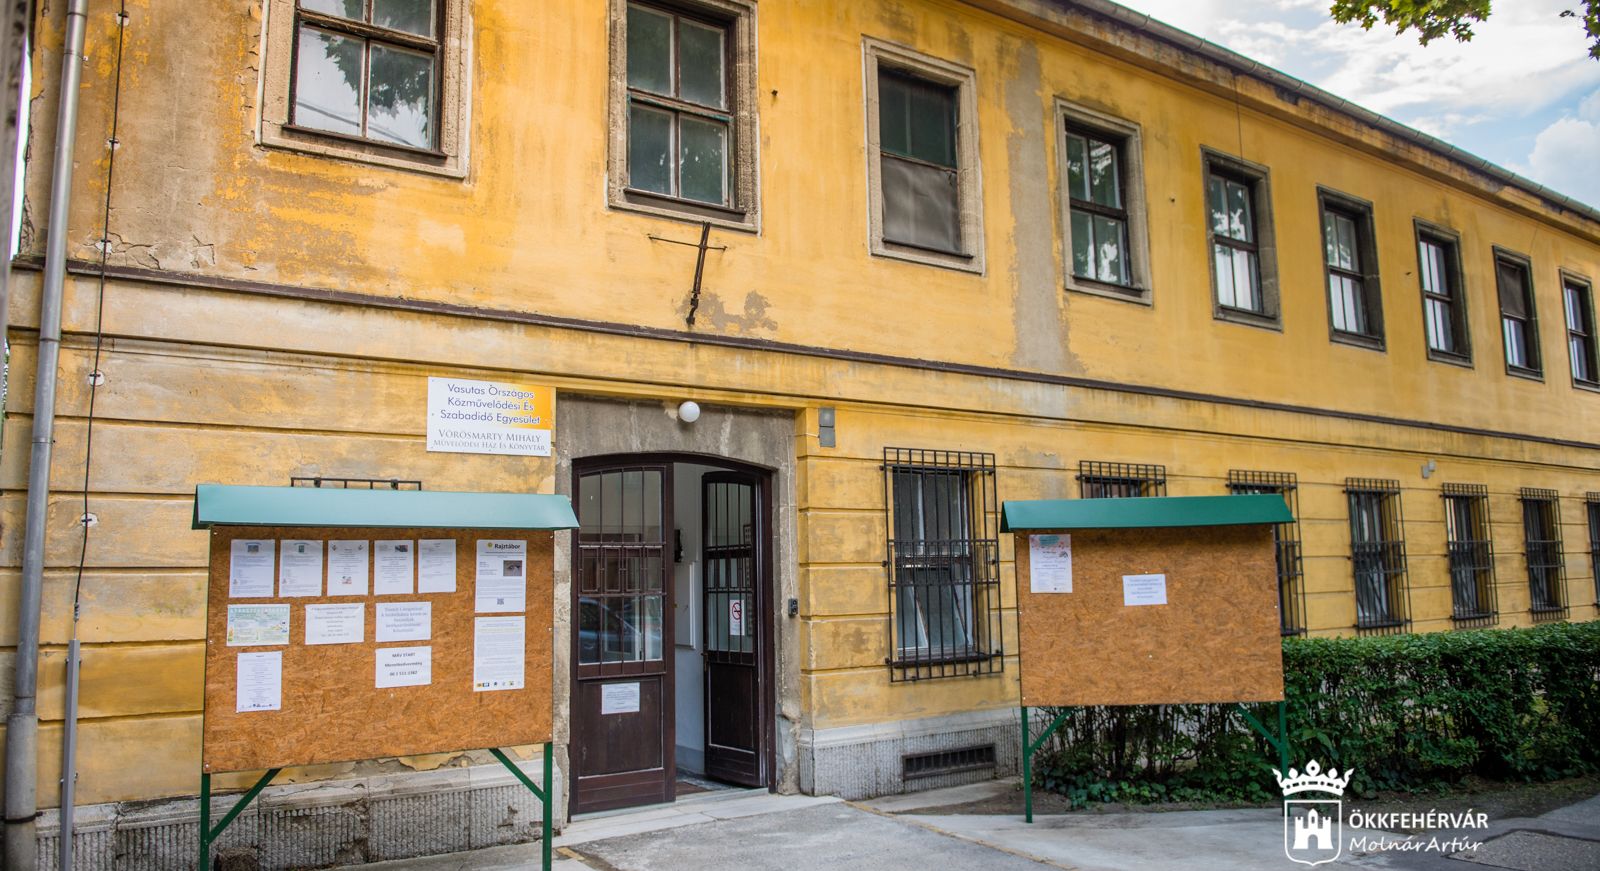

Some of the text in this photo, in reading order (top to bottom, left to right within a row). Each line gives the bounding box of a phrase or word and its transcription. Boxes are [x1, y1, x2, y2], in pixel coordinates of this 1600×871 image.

[447, 383, 486, 395] Vasutas
[447, 396, 534, 411] Közművelődési És
[440, 409, 541, 425] Szabadidő Egyesület
